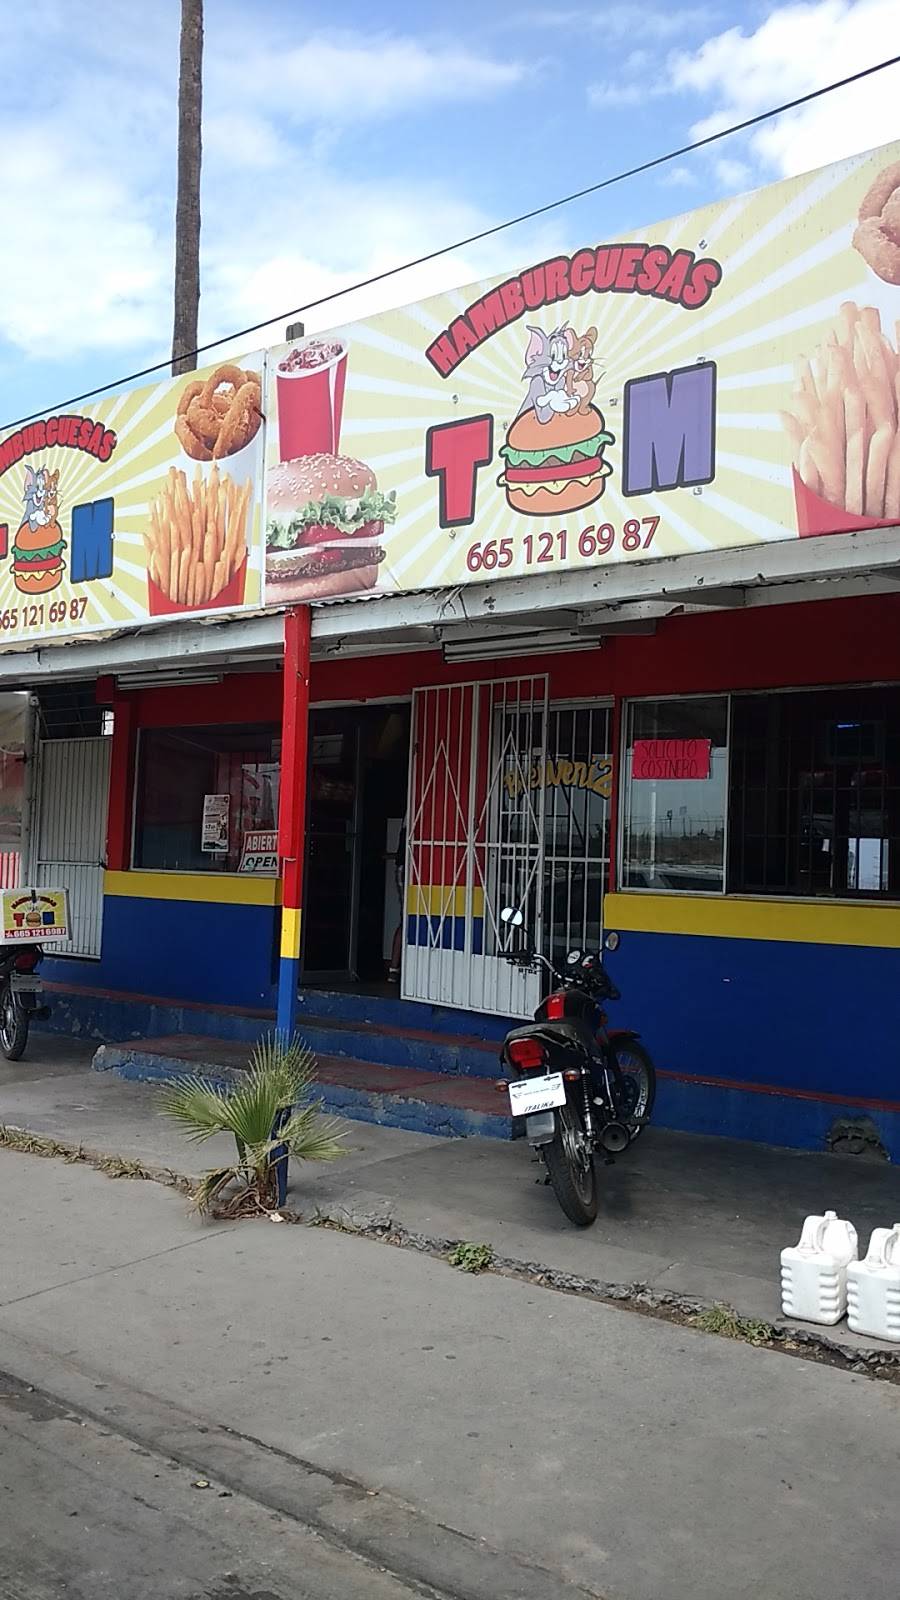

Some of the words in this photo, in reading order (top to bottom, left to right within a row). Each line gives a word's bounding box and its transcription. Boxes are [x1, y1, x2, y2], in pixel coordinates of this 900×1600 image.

[425, 243, 722, 379] HAMBURGUESAS
[425, 413, 494, 529] T
[622, 361, 717, 497] M
[70, 497, 114, 584] M
[466, 538, 514, 573] 665
[523, 530, 568, 563] 121
[578, 523, 615, 556] 69
[622, 516, 661, 551] 87
[22, 604, 44, 627] 121
[49, 600, 67, 623] 69
[69, 596, 88, 620] 87
[641, 740, 697, 759] SOLICITO
[640, 759, 698, 778] COSINERO
[245, 856, 277, 868] OPEN
[31, 929, 44, 937] 121
[524, 1100, 554, 1112] ITALIKA
